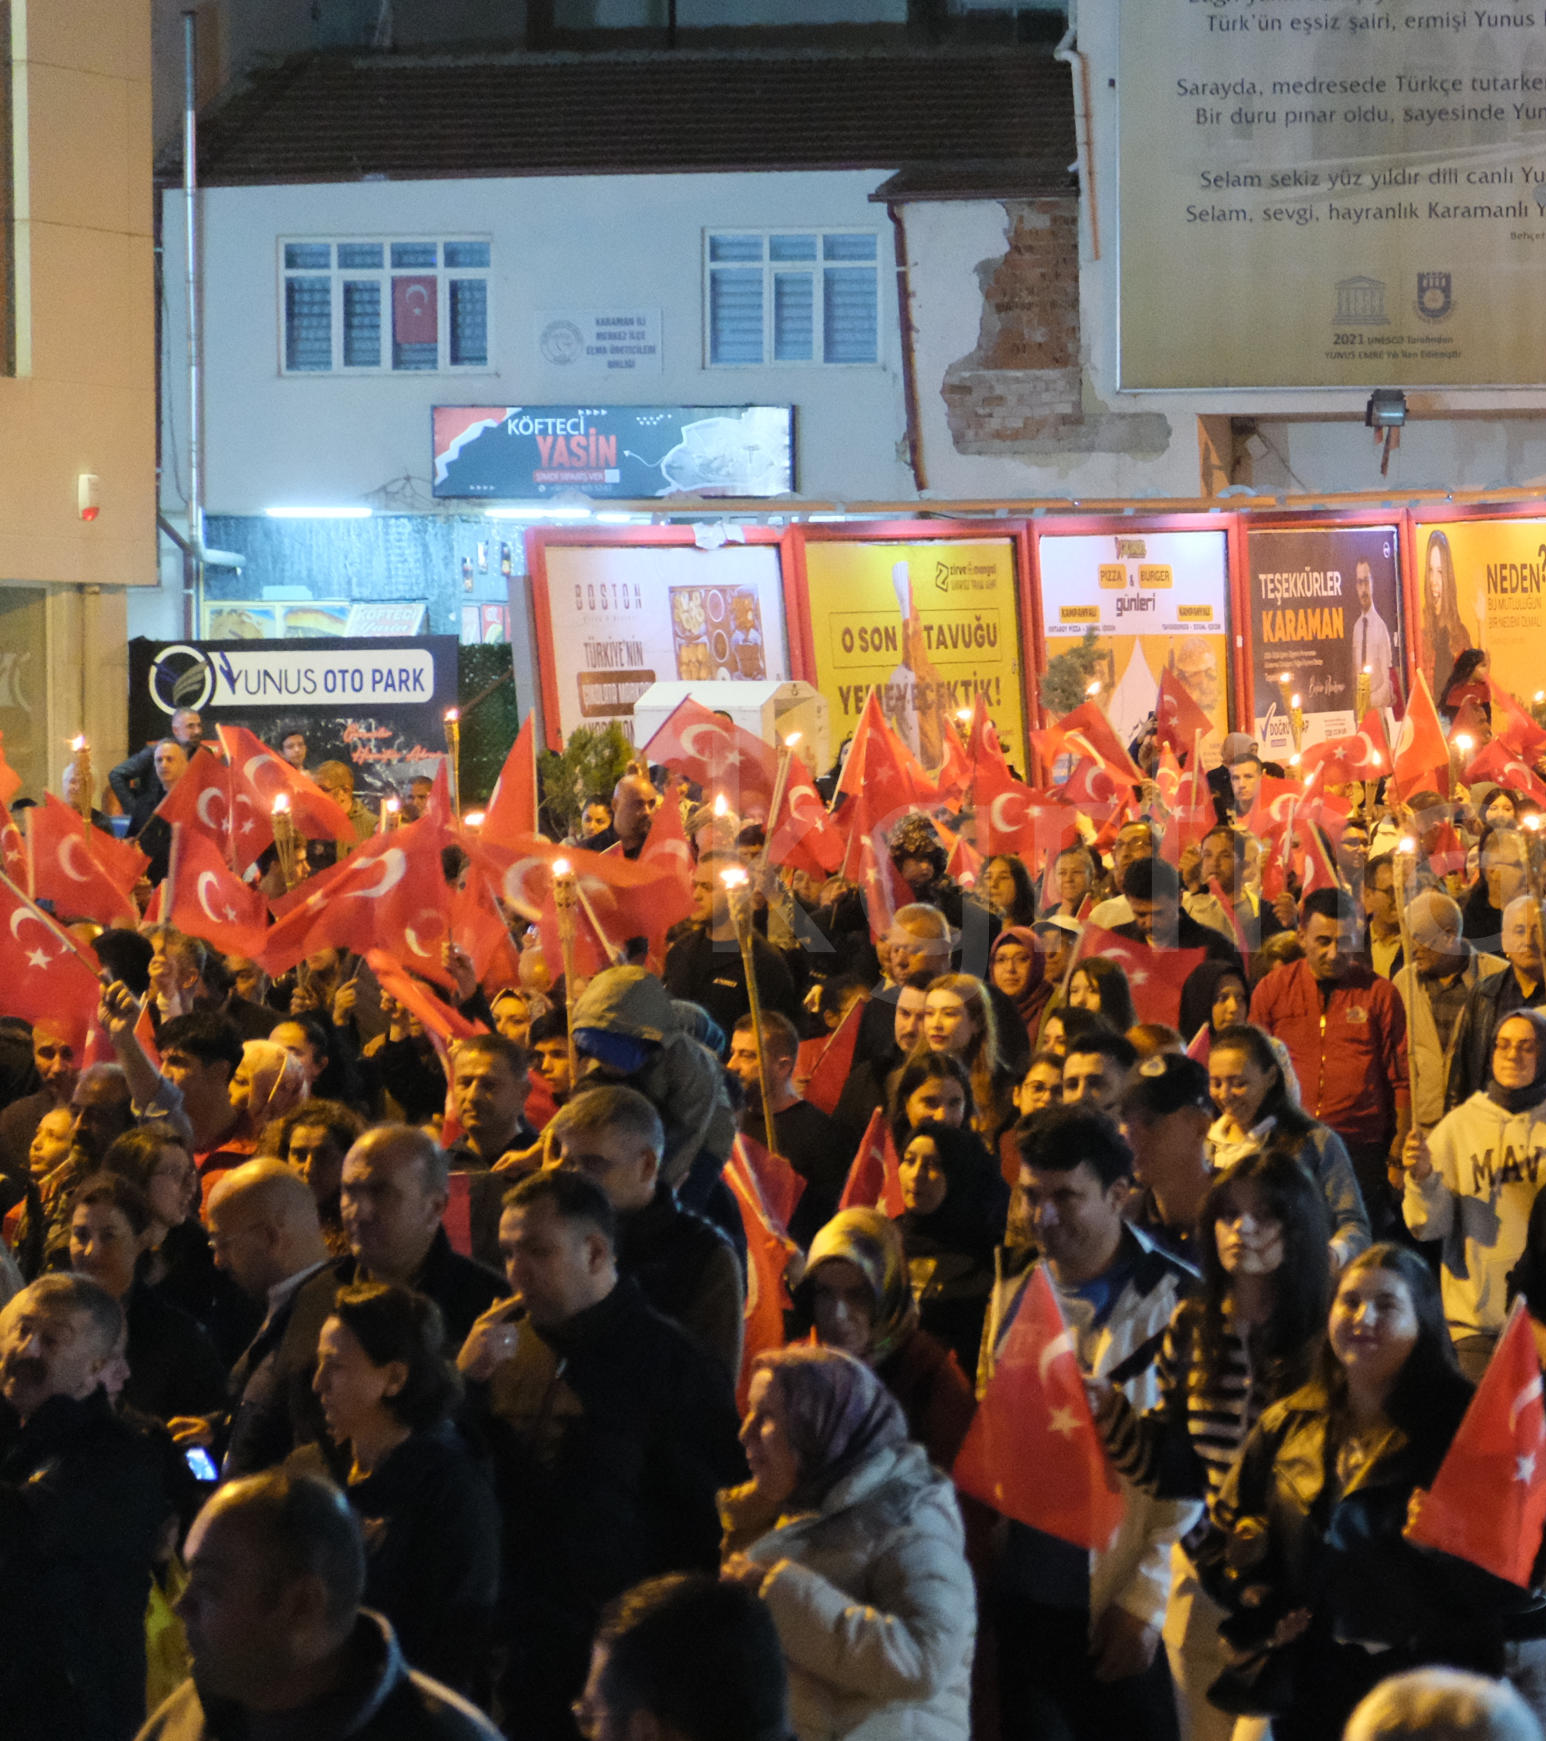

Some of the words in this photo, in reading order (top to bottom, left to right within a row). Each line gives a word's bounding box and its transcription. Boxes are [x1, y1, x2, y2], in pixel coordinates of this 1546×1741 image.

[1207, 14, 1282, 32] Türk'ün
[1290, 13, 1341, 35] eşsiz
[1349, 13, 1396, 34] şairi,
[1404, 11, 1467, 33] ermişi
[1474, 10, 1535, 28] Yunus
[1176, 78, 1264, 100] Sarayda,
[1272, 76, 1387, 96] medresede
[1396, 74, 1463, 95] Türkçe
[1196, 106, 1222, 125] Bir
[1230, 106, 1276, 125] duru
[1285, 108, 1336, 127] pınar
[1344, 106, 1395, 124] oldu,
[1403, 103, 1505, 125] sayesinde
[1200, 170, 1262, 189] Selam
[1270, 169, 1321, 187] sekiz
[1327, 170, 1363, 191] yüz
[1371, 168, 1420, 190] yıldır
[1428, 167, 1458, 185] dili
[1466, 167, 1514, 184] canlı
[1186, 204, 1253, 223] Selam,
[1262, 204, 1320, 225] sevgi,
[1328, 202, 1420, 224] hayranlık
[1428, 201, 1528, 219] Karamanlı
[1333, 333, 1364, 345] 2021
[1325, 351, 1355, 360] YUNUS
[507, 415, 585, 436] KÖFTECİ
[536, 427, 617, 468] YASİN
[1100, 570, 1123, 582] PIZZA
[1140, 570, 1170, 582] BURGER
[1259, 566, 1342, 606] TEŞEKKÜRLER
[574, 583, 643, 611] BOSTON
[1115, 593, 1156, 617] günleri
[841, 626, 854, 653] O
[858, 625, 898, 653] SON
[923, 615, 998, 650] TAVUĞU
[1262, 607, 1344, 643] KARAMAN
[584, 635, 644, 668] TÜRKİYE'NİN
[218, 651, 318, 695] YUNUS
[324, 669, 364, 693] OTO
[371, 668, 426, 693] PARK
